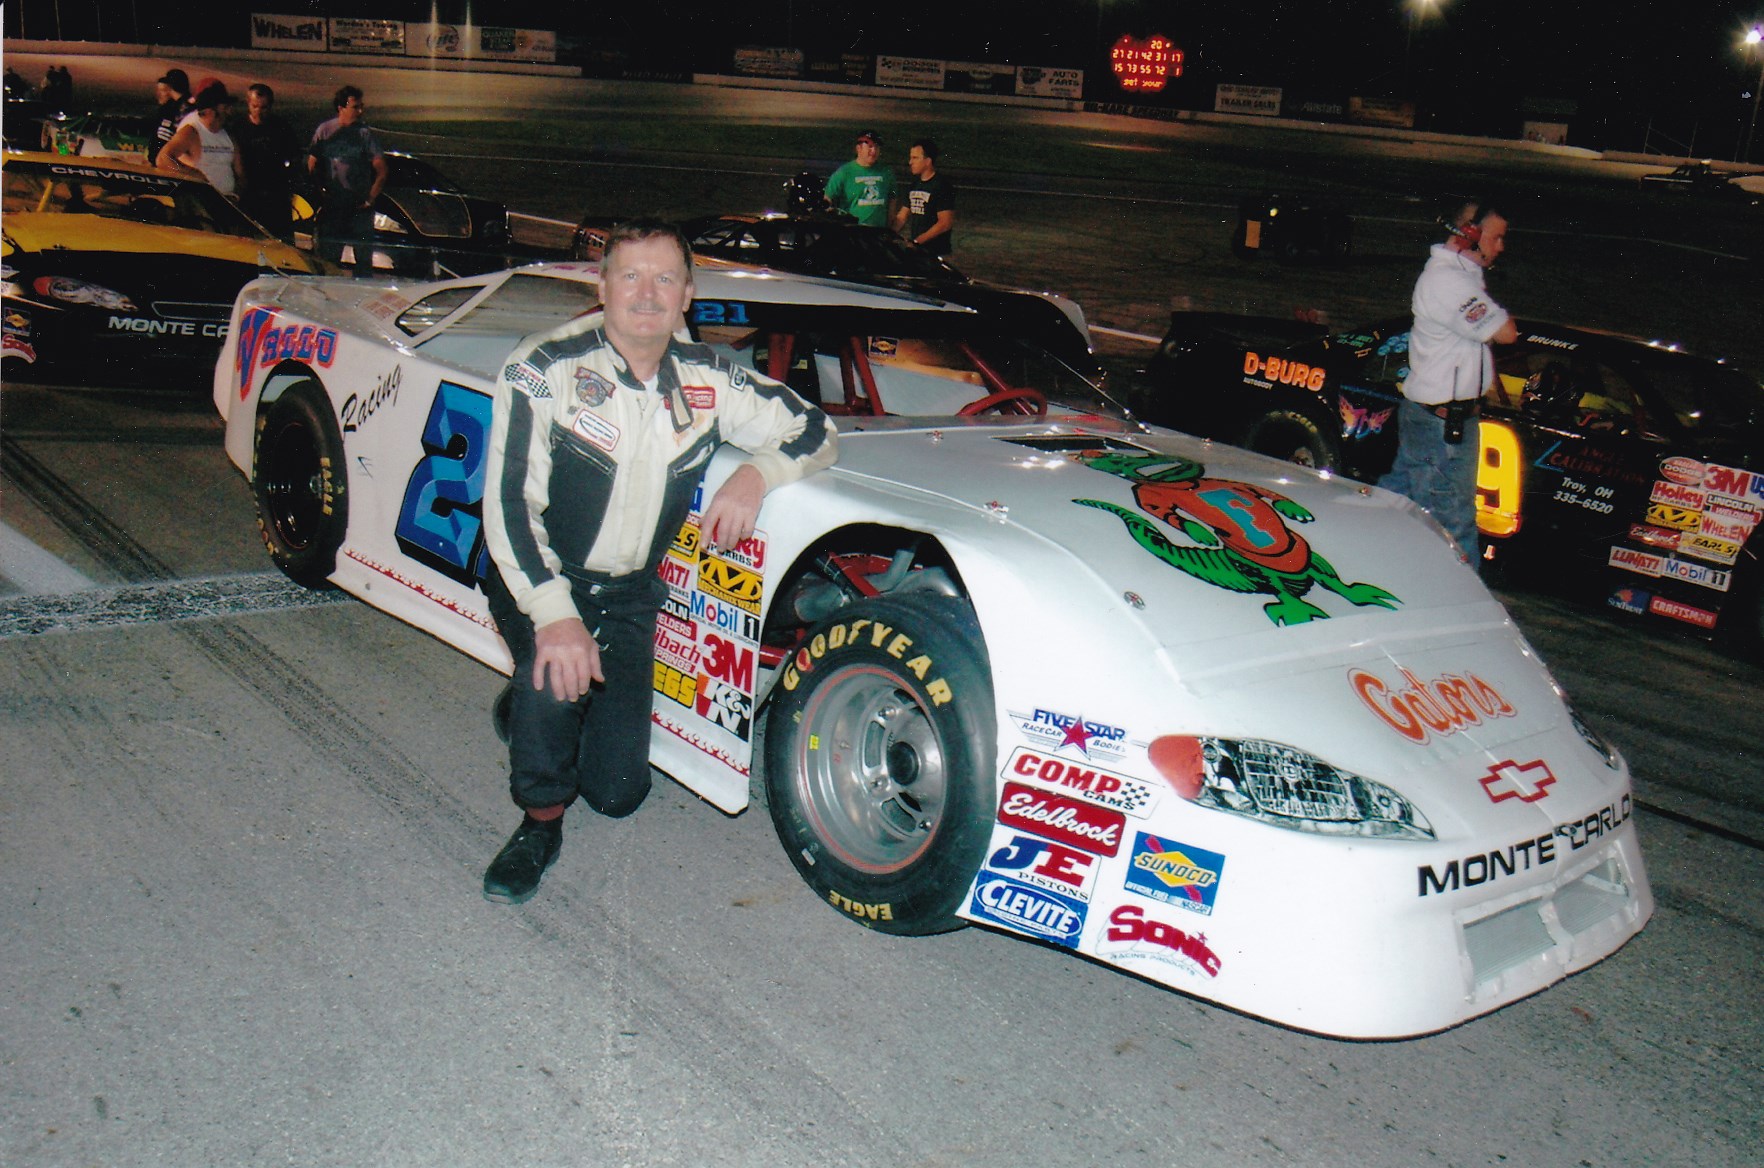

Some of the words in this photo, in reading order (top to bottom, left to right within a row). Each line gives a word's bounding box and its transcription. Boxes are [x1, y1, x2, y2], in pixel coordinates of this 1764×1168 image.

[253, 16, 323, 41] WHELEN
[1113, 48, 1125, 59] 27
[1127, 50, 1139, 60] 21
[1141, 51, 1153, 61] 42
[1156, 52, 1167, 62] 31
[1172, 53, 1181, 63] 17
[1151, 40, 1163, 50] 20
[1048, 78, 1080, 87] PARTS
[1052, 71, 1079, 79] AUTO
[1115, 62, 1123, 73] 15
[1127, 63, 1138, 74] 73
[1140, 64, 1151, 75] 55
[1156, 65, 1166, 76] 72
[1176, 67, 1180, 76] 1
[1300, 102, 1343, 115] Allstate
[51, 166, 181, 188] CHEVROLET
[108, 316, 196, 335] MONTE
[202, 324, 229, 338] CA
[692, 302, 750, 324] 21
[1526, 334, 1579, 351] BRUNKE
[1243, 351, 1327, 392] D-BURG
[340, 363, 403, 433] Racing
[394, 378, 495, 590] 2
[1561, 476, 1587, 494] Troy,
[1594, 485, 1614, 499] OH
[1652, 481, 1703, 508] Holley
[1703, 465, 1751, 497] 3M
[1553, 490, 1614, 515] 335-6520
[1707, 493, 1755, 511] LINCOLN
[1702, 514, 1751, 542] WHELEN
[657, 556, 690, 590] NATI
[1611, 549, 1660, 571] LUNATI
[1665, 559, 1707, 581] Mobil
[661, 599, 689, 621] OLN
[690, 590, 738, 633] Mobil
[1652, 600, 1713, 625] CRAFTSMAN
[655, 628, 700, 664] ibach
[702, 633, 754, 696] 3M
[783, 619, 953, 706] GOODYEAR
[653, 660, 697, 708] EGS
[1348, 667, 1518, 745] Gators
[1033, 709, 1075, 730] FIVE
[1083, 721, 1126, 742] STAR
[1013, 753, 1122, 794] COMP
[1083, 789, 1136, 811] CAMS
[1003, 793, 1118, 847] Edelbrock
[1417, 832, 1556, 897] MONTE
[1565, 792, 1632, 851] CARLO
[989, 835, 1094, 888] JE
[1136, 854, 1215, 886] SUNOCO
[1016, 871, 1090, 902] PISTONS
[829, 889, 894, 922] EAGLE
[981, 879, 1077, 934] CLEVITE
